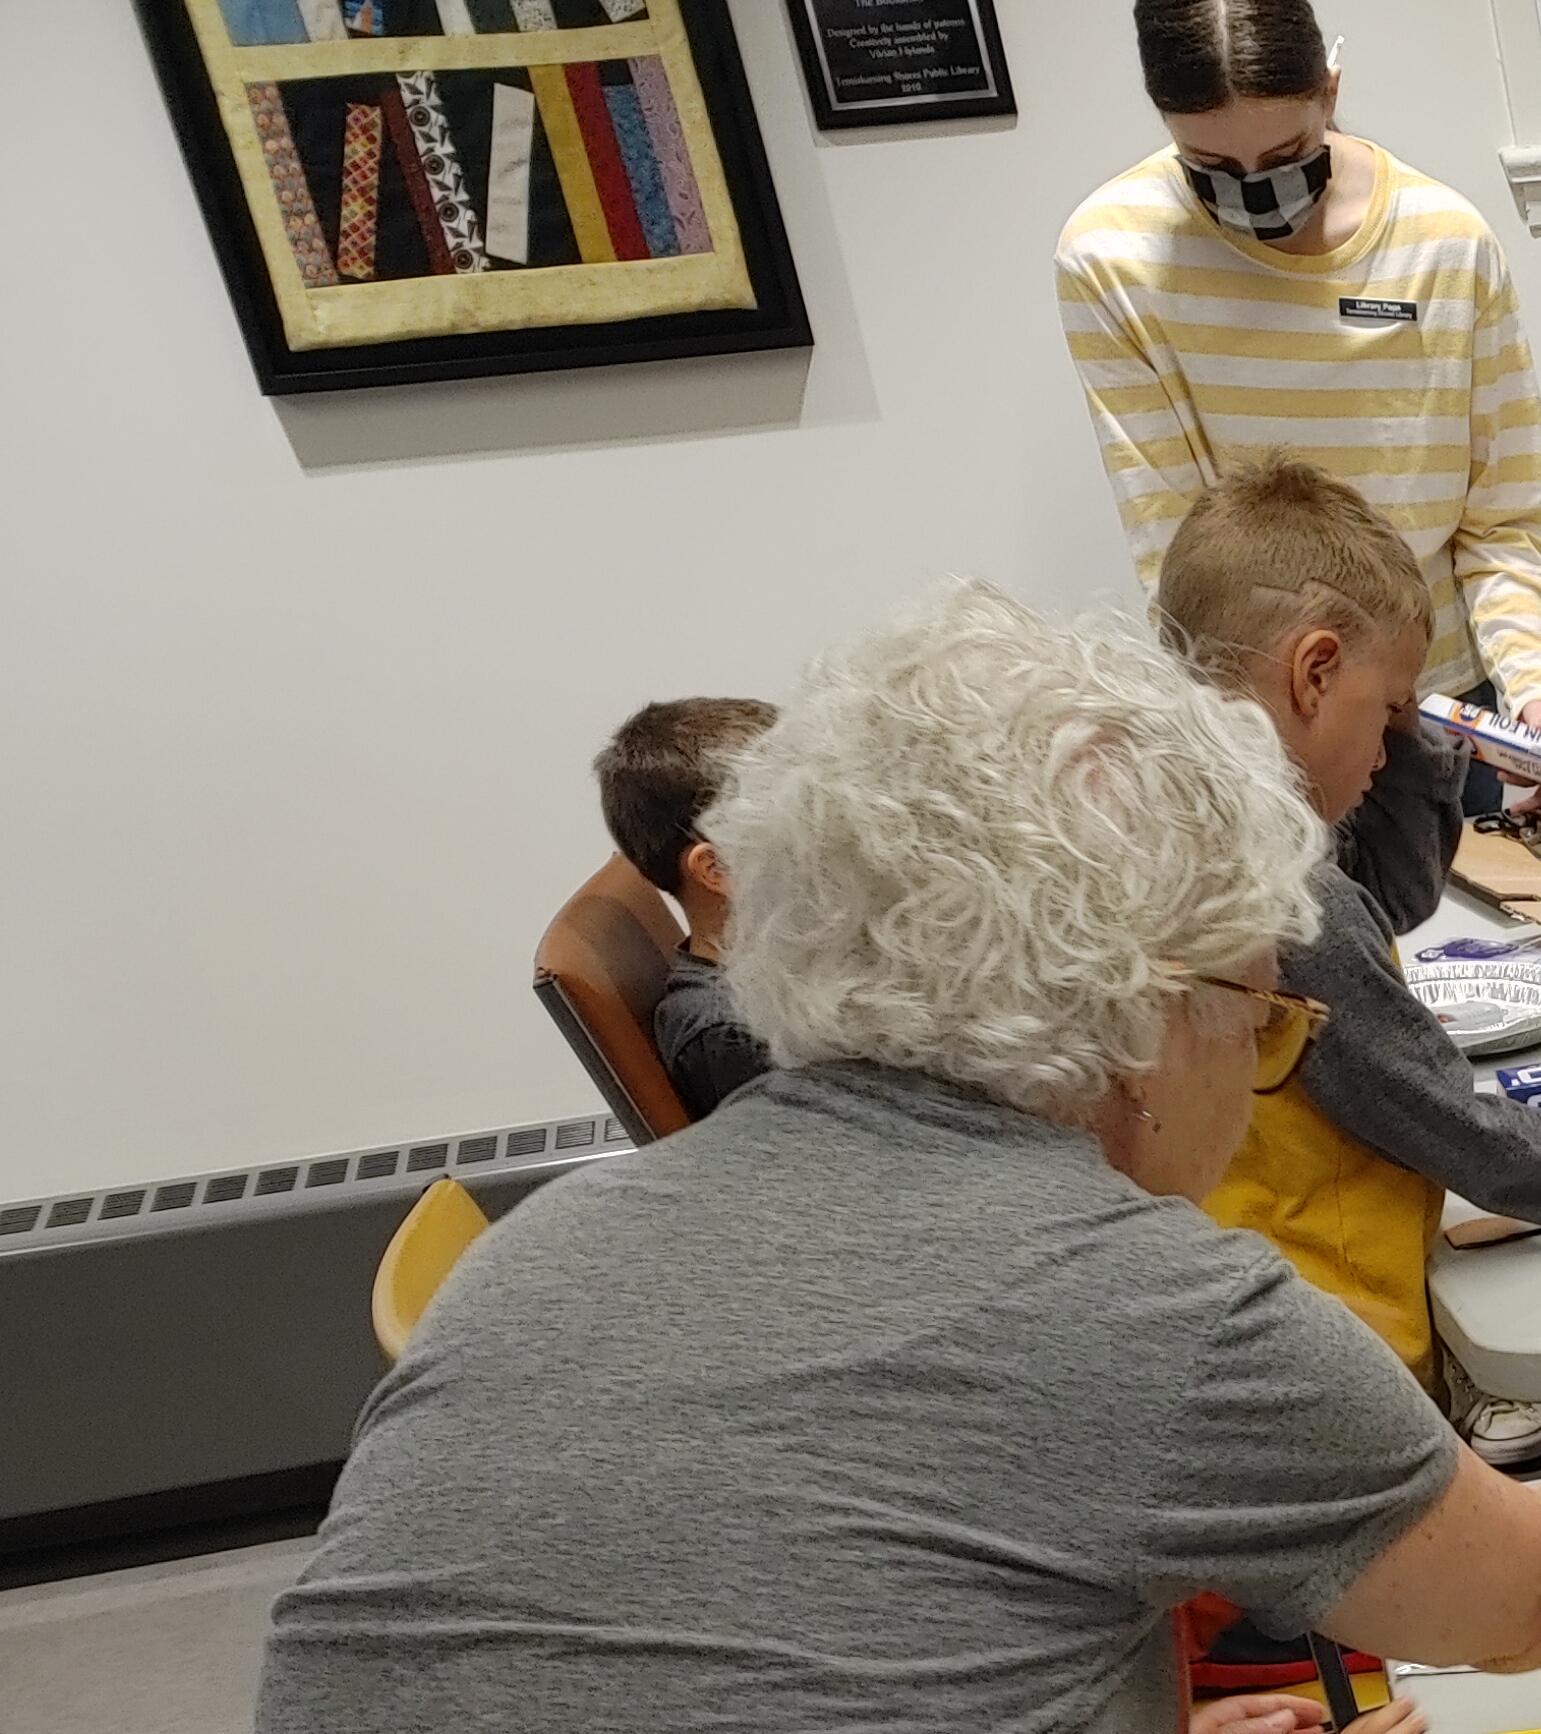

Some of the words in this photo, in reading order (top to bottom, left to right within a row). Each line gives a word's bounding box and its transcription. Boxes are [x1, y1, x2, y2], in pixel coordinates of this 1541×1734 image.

[867, 24, 878, 35] by
[922, 19, 933, 29] of
[937, 30, 949, 41] by
[922, 66, 947, 77] Public
[949, 63, 981, 78] Library
[1488, 711, 1520, 734] FOIL
